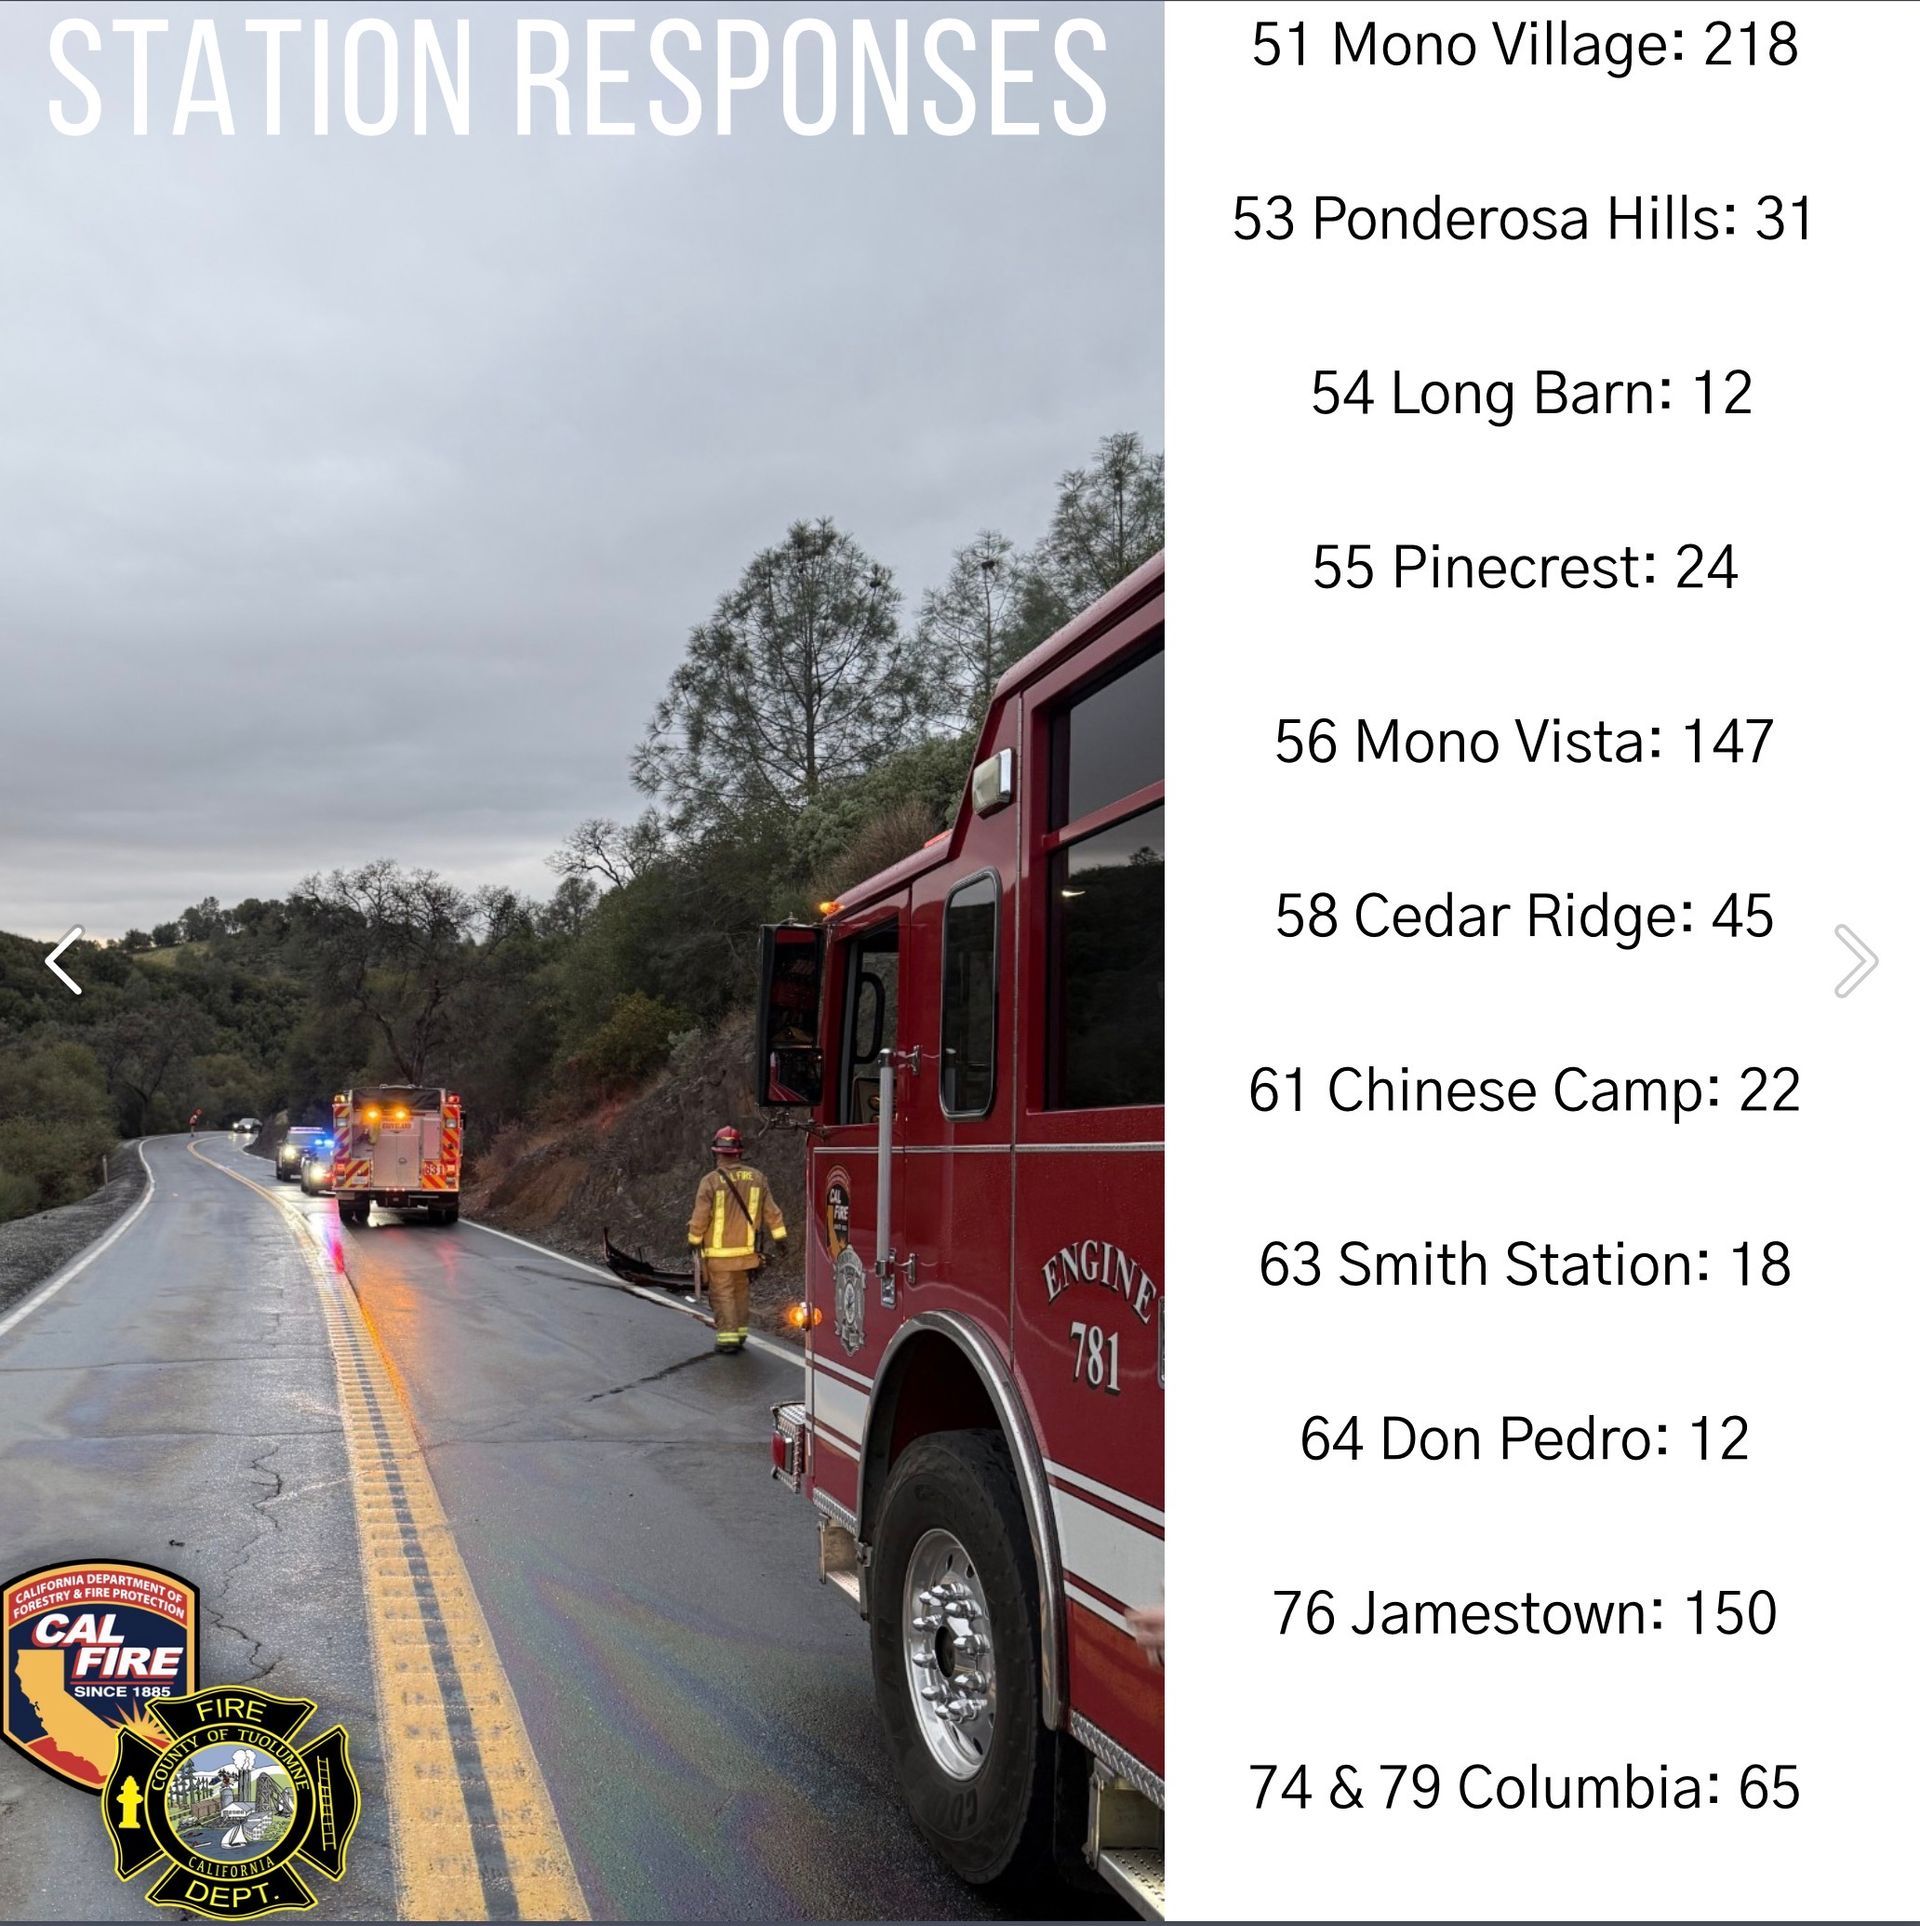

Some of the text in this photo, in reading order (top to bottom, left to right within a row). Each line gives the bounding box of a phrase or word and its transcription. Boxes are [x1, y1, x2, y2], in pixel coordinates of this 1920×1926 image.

[833, 1204, 849, 1221] FIRE
[1040, 1239, 1157, 1325] ENGINE
[1070, 1321, 1121, 1393] 781
